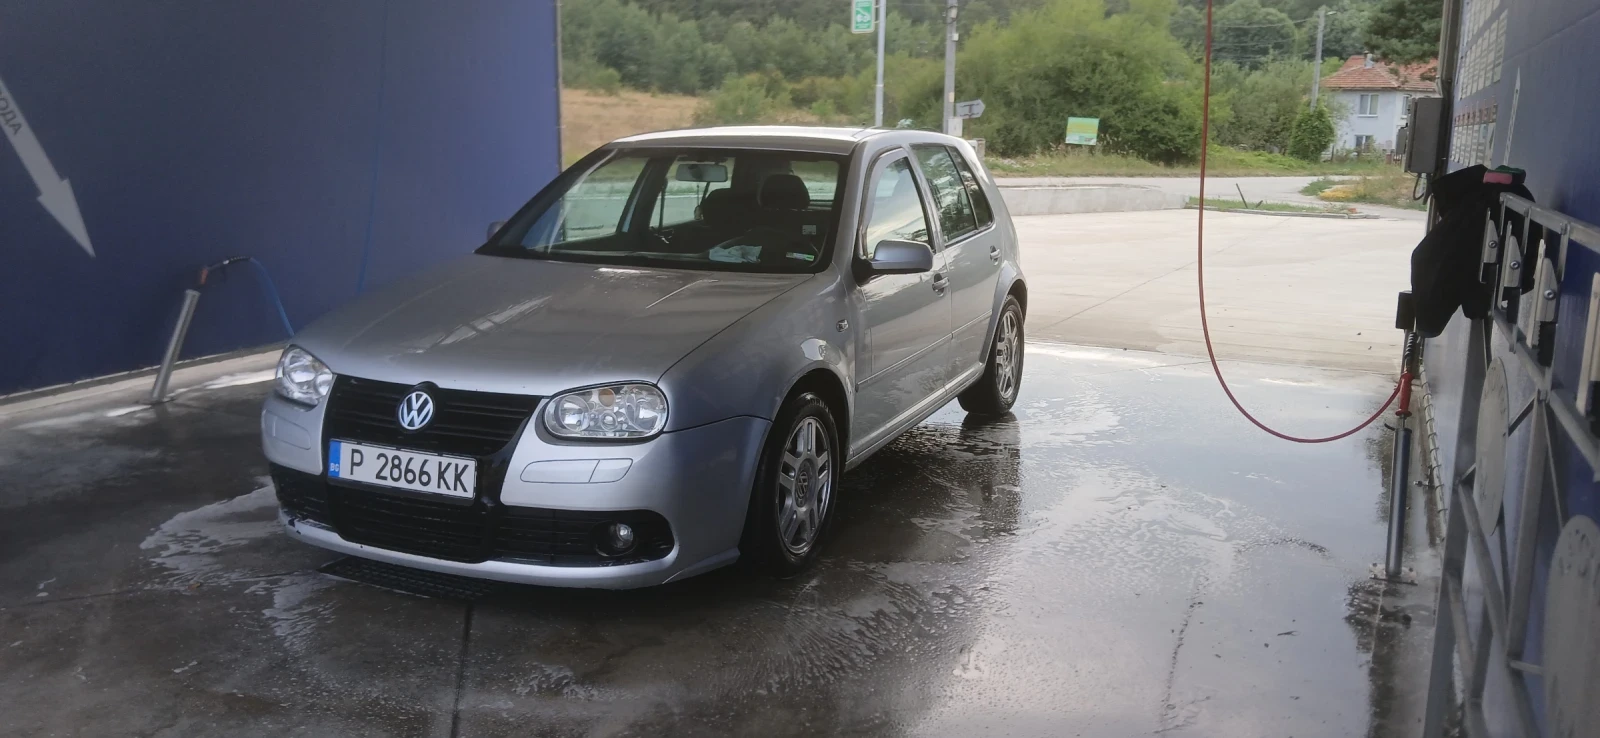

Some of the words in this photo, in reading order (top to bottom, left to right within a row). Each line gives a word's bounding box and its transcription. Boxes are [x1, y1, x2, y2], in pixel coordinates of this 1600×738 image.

[0, 91, 22, 136] ОДА
[400, 391, 434, 430] VW
[330, 463, 340, 472] BG
[350, 448, 364, 476] P
[375, 452, 432, 487] 2866
[437, 461, 469, 493] KK
